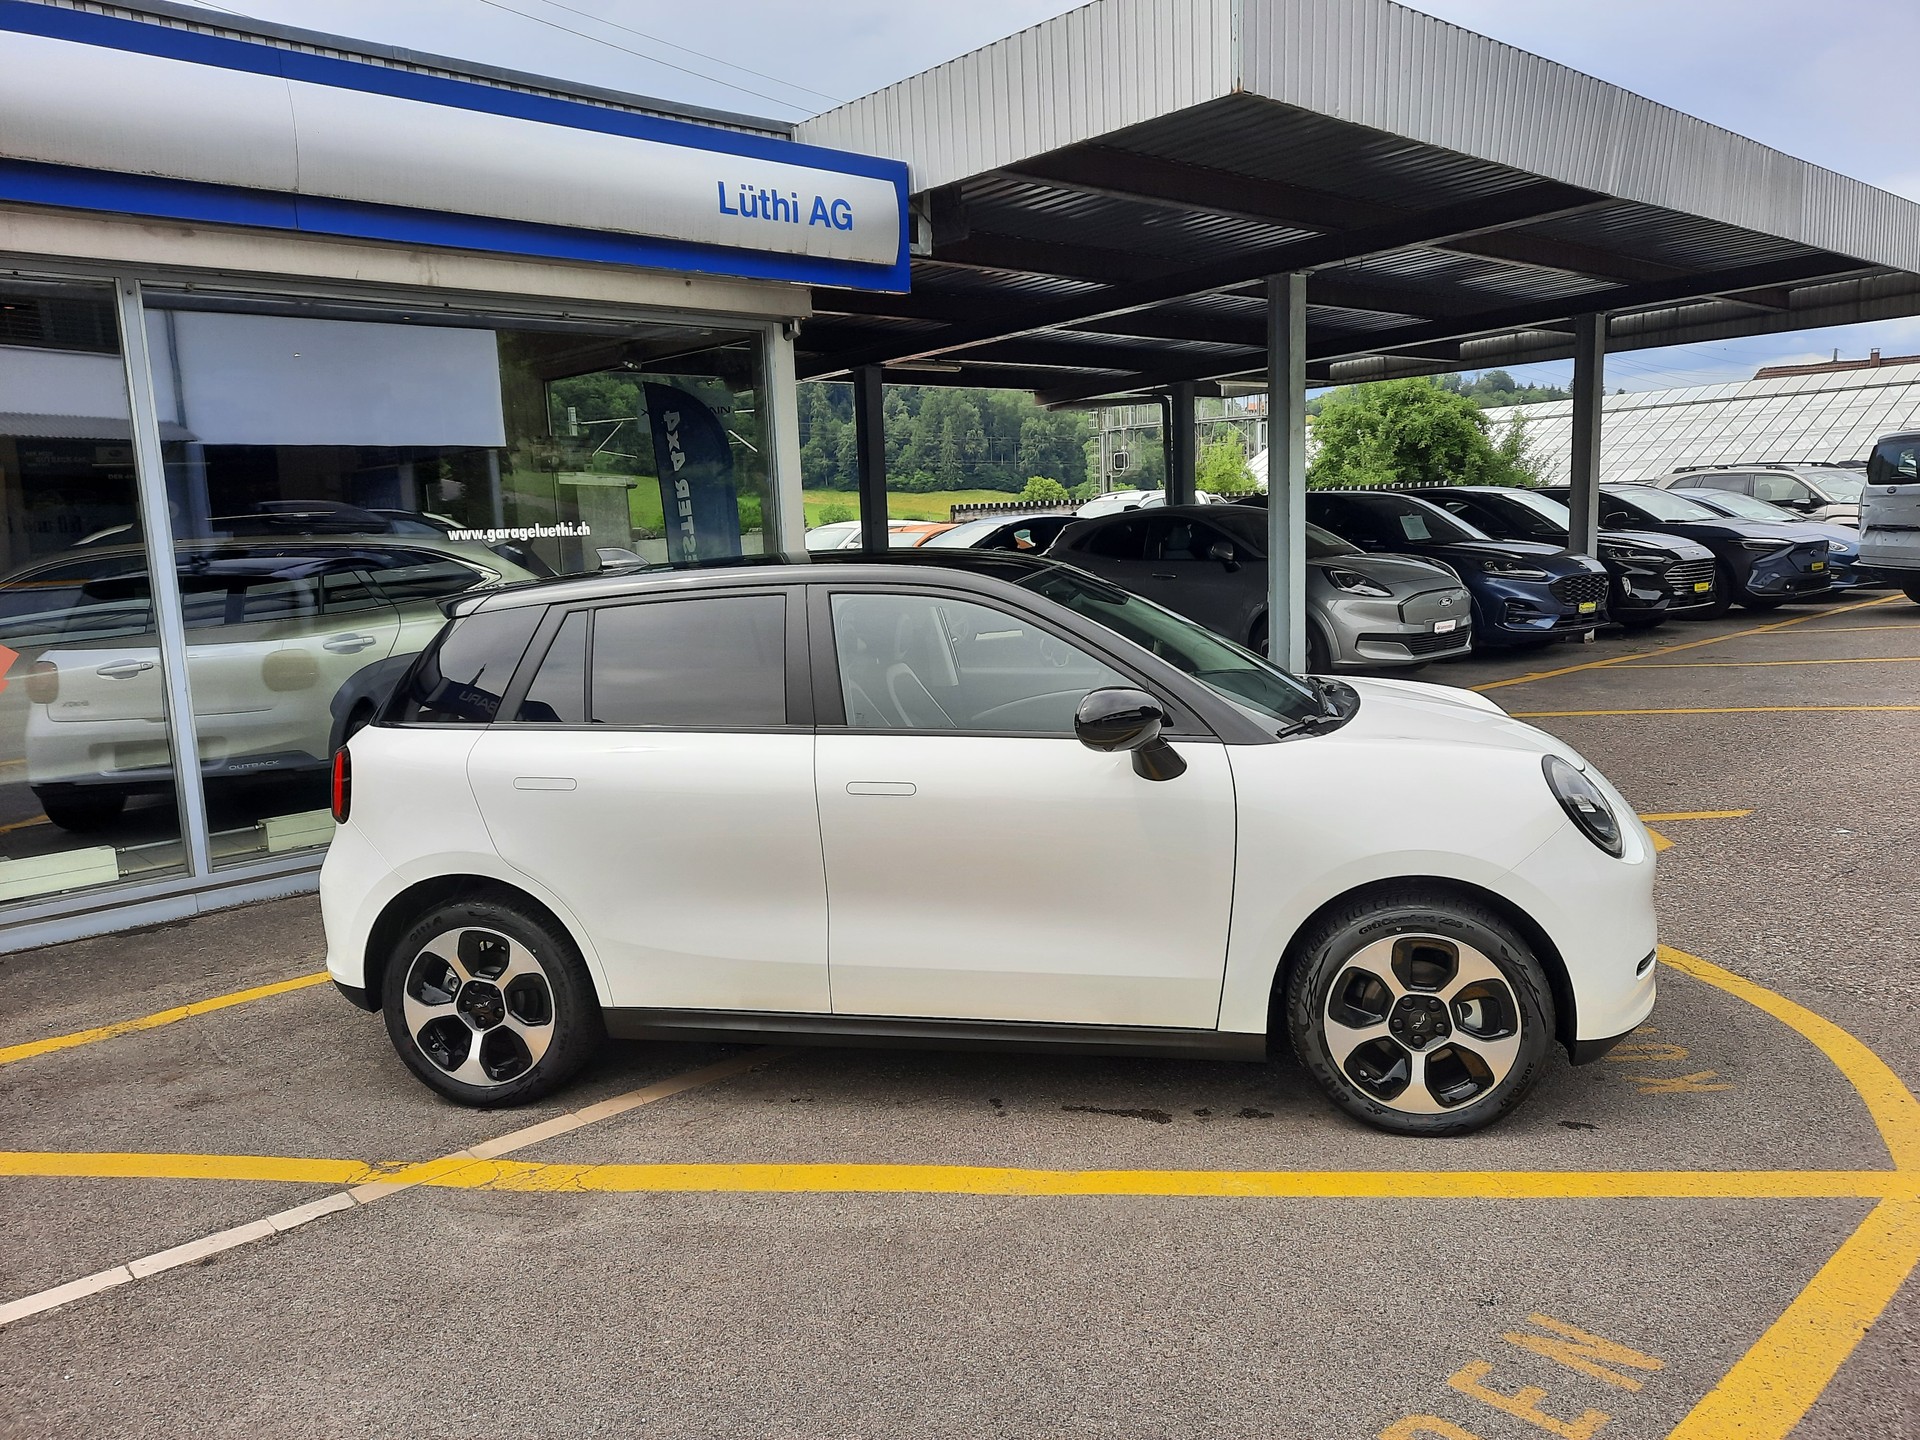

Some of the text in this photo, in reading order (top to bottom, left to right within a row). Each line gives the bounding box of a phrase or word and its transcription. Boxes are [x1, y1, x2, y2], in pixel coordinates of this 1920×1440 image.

[717, 180, 854, 231] Lüthi AG
[447, 520, 591, 543] www.garageluethi.ch
[228, 759, 280, 771] OUTBACK
